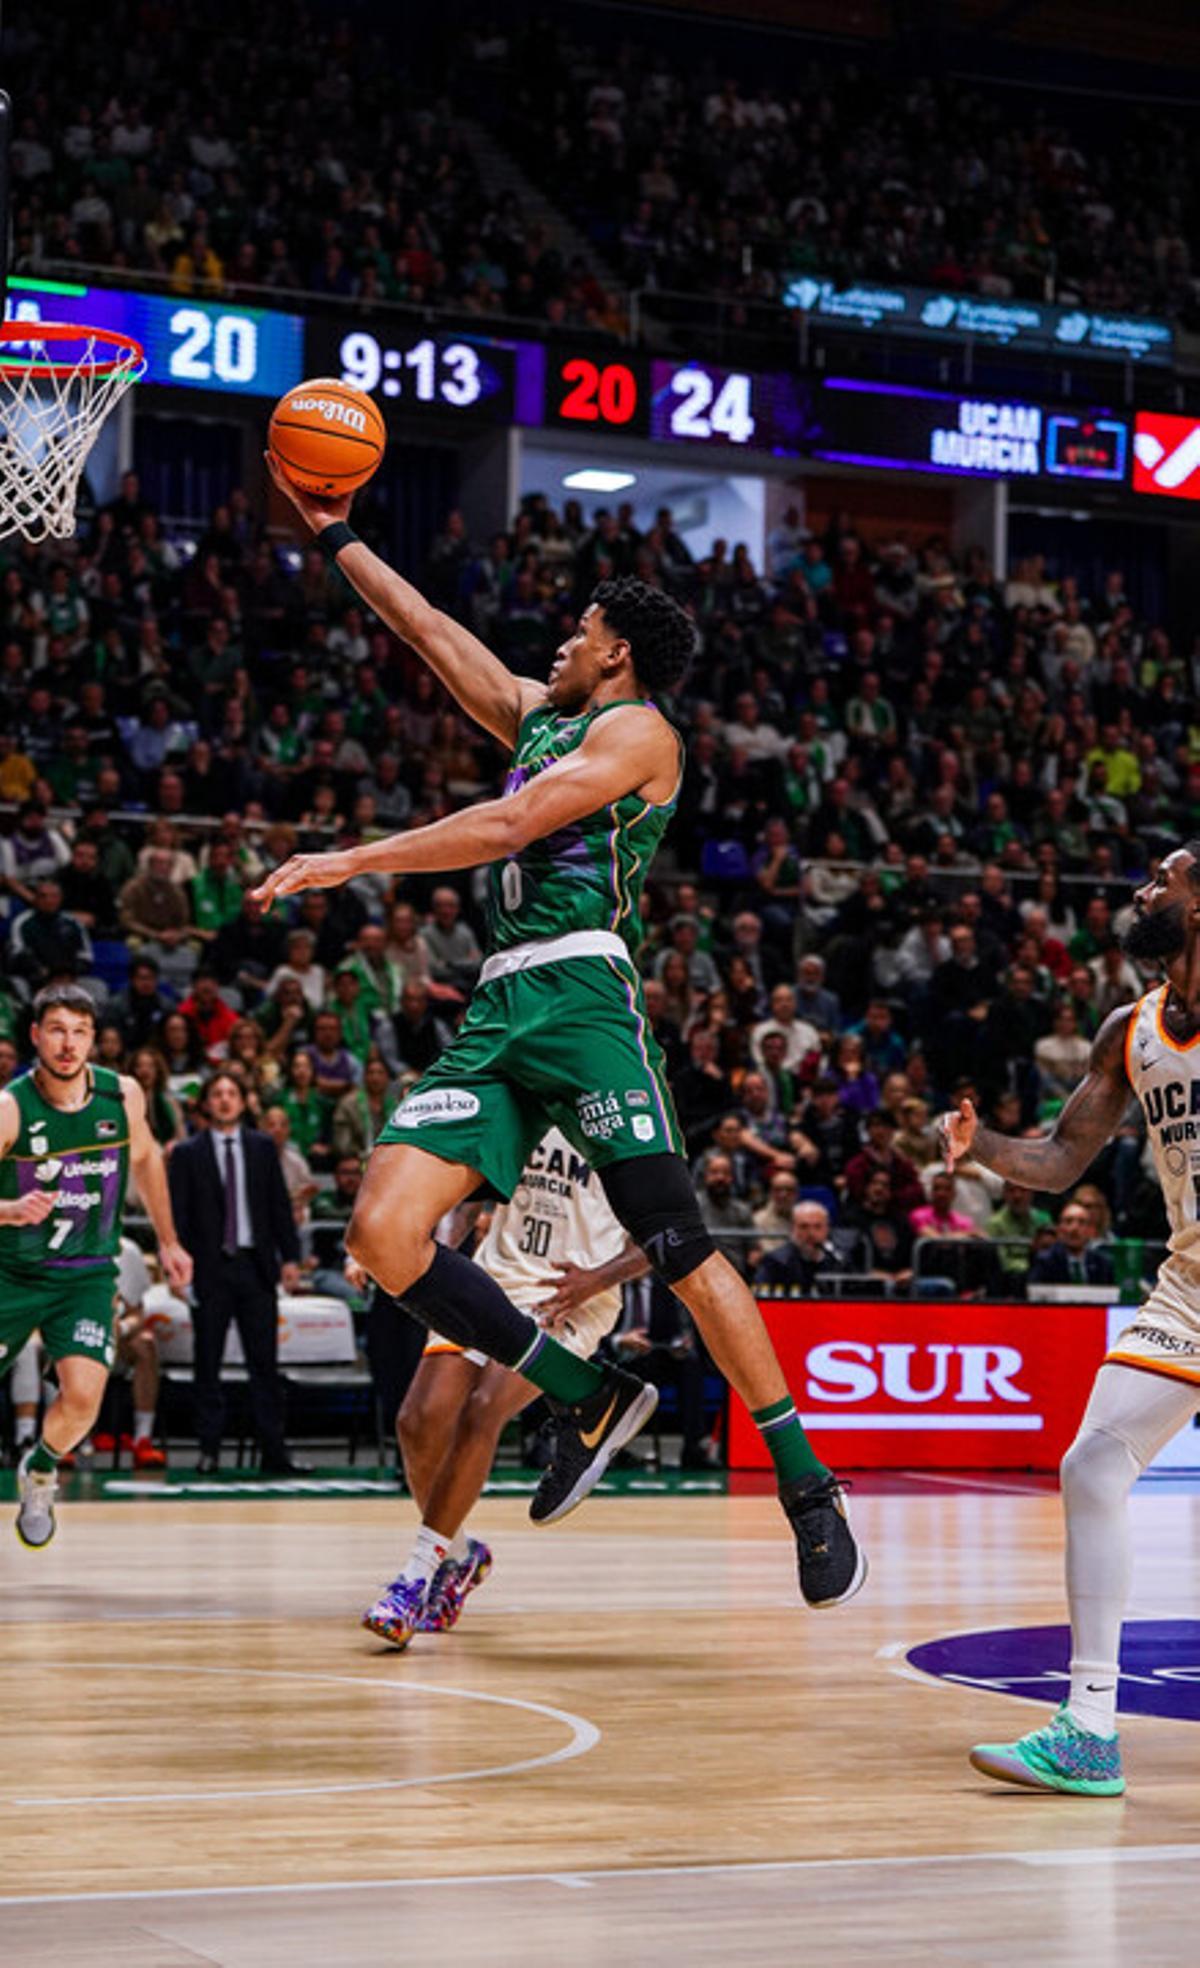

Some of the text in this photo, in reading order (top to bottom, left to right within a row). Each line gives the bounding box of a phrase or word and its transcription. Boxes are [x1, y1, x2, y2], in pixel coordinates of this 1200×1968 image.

[170, 309, 257, 383] 20
[340, 331, 481, 406] 9:13
[559, 358, 637, 425] 20
[671, 369, 755, 443] 24
[291, 398, 366, 434] Wilson
[959, 401, 1041, 443] UCAM
[931, 429, 1039, 475] MURCIA
[1160, 1120, 1200, 1147] MUR
[527, 1145, 590, 1189] CAM
[48, 1219, 74, 1250] 7
[518, 1215, 553, 1258] 30
[805, 1341, 1032, 1403] SUR
